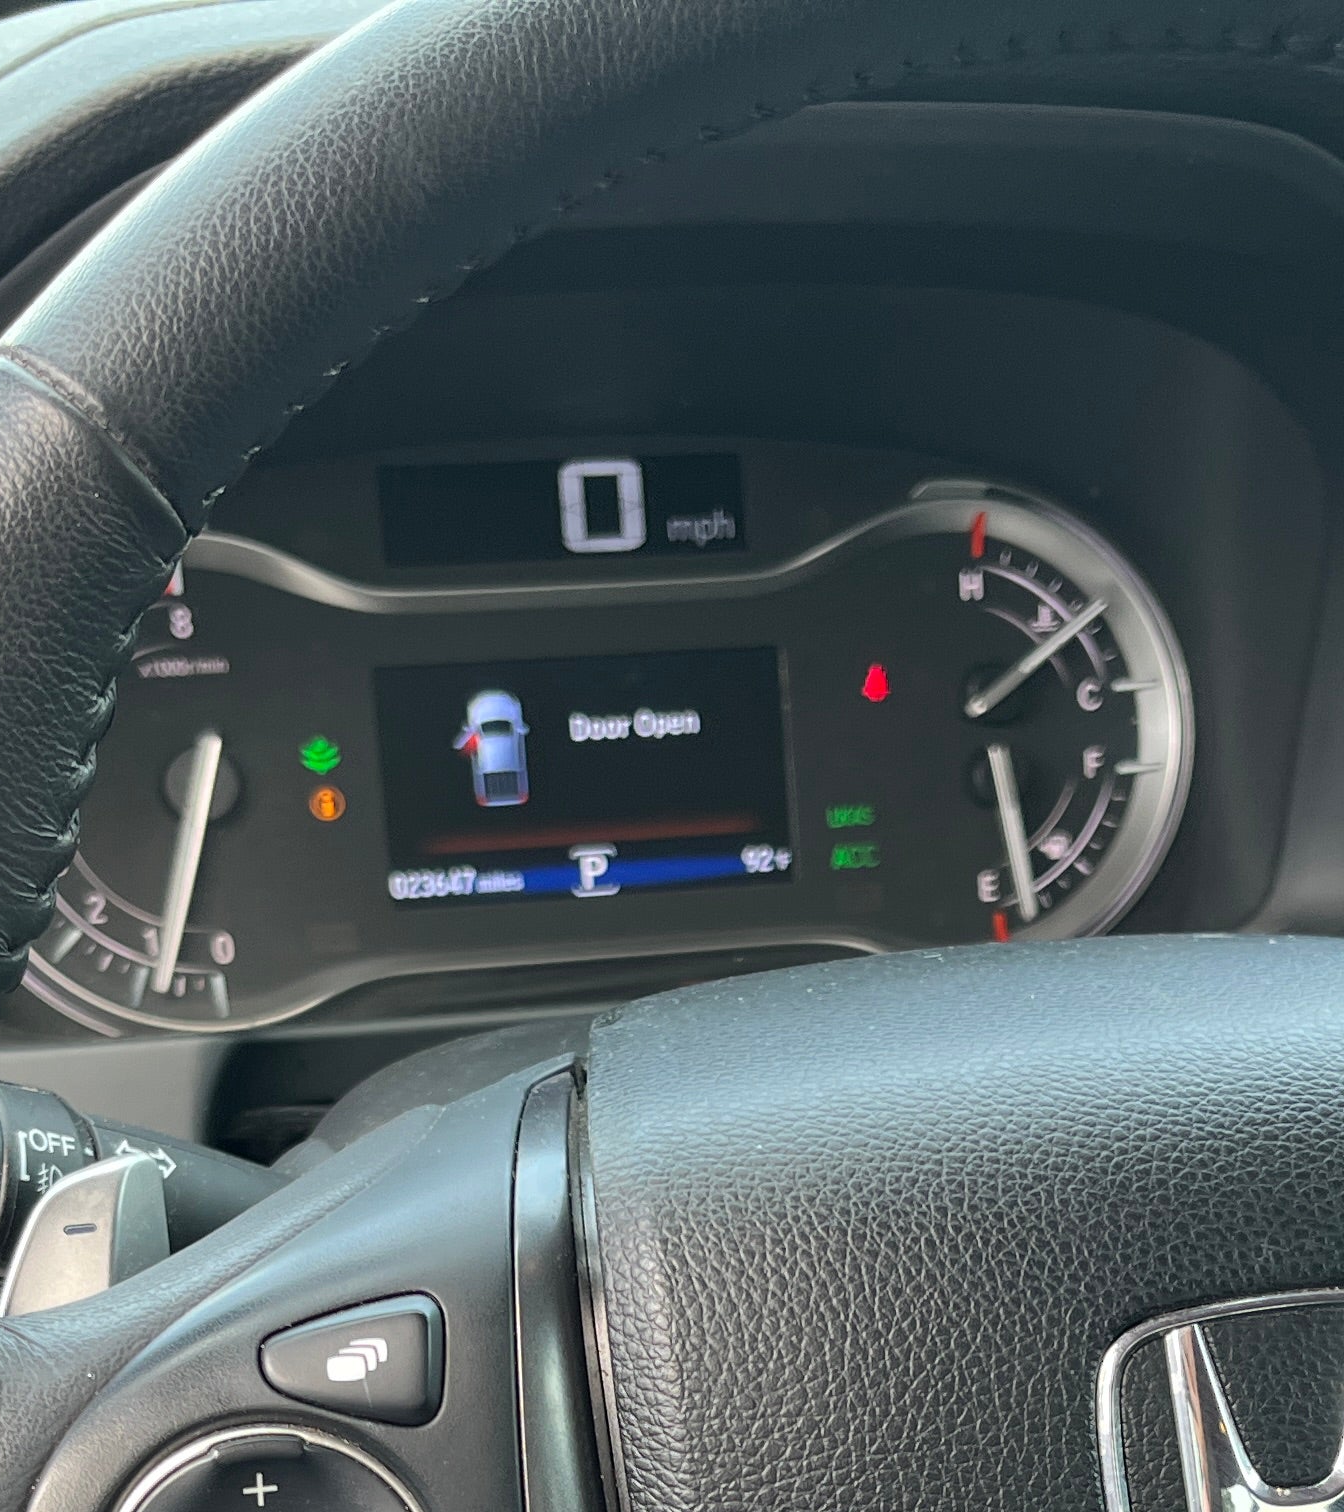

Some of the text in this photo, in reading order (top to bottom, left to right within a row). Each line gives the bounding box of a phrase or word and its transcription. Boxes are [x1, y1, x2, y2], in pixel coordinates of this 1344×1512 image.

[558, 459, 736, 554] 0 mph
[959, 570, 984, 601] H
[169, 602, 194, 639] 8
[1076, 677, 1104, 712] C
[568, 706, 701, 742] Door Open
[1083, 746, 1105, 779] F
[476, 869, 526, 894] miles
[578, 853, 609, 891] P
[977, 868, 1001, 904] E
[83, 891, 109, 926] 2
[210, 930, 236, 966] 0
[29, 1129, 76, 1157] OFF
